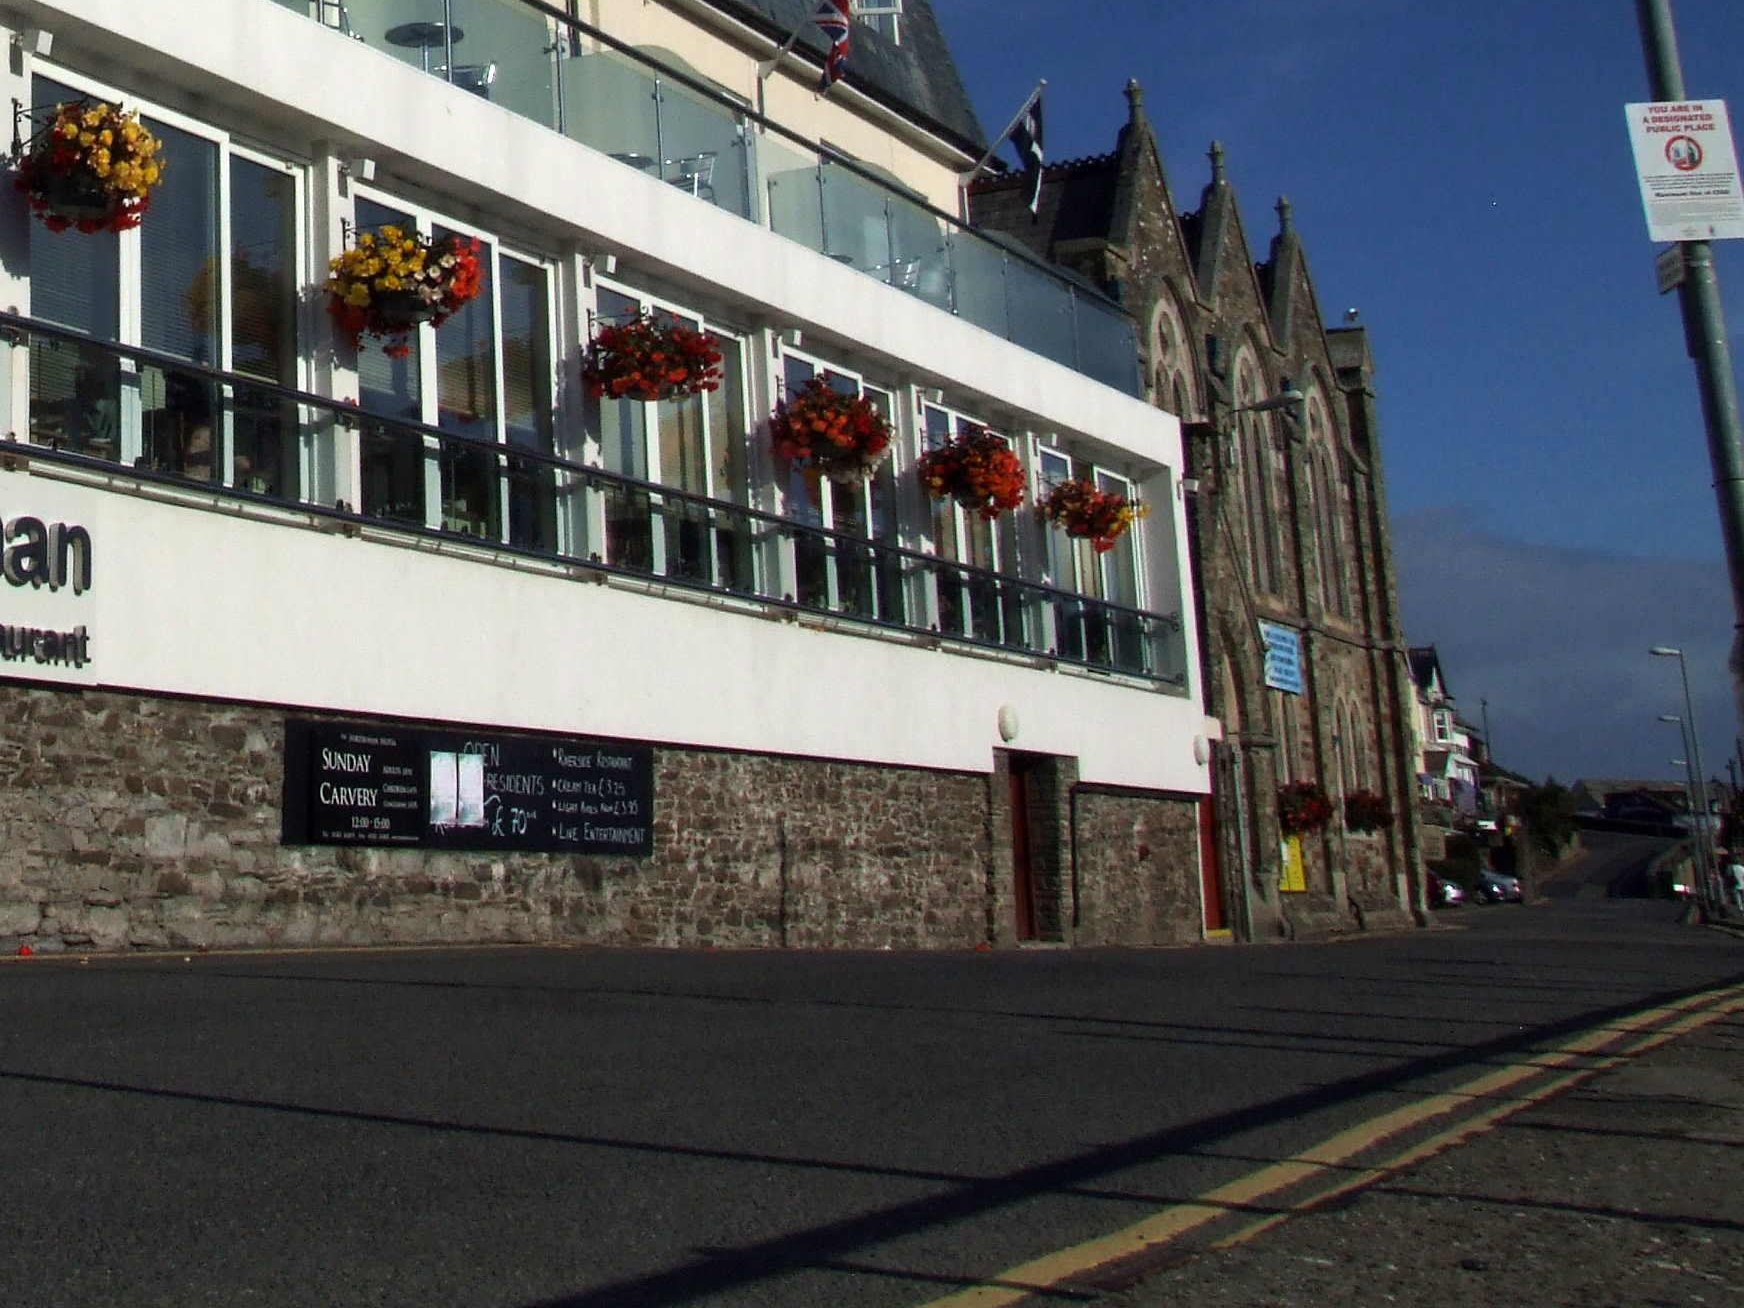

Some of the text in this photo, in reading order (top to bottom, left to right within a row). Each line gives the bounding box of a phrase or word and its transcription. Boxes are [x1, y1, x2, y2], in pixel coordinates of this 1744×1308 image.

[1645, 123, 1716, 133] PUBLIC PLACE
[322, 747, 371, 772] SUNDAY
[319, 782, 378, 807] CARVERY
